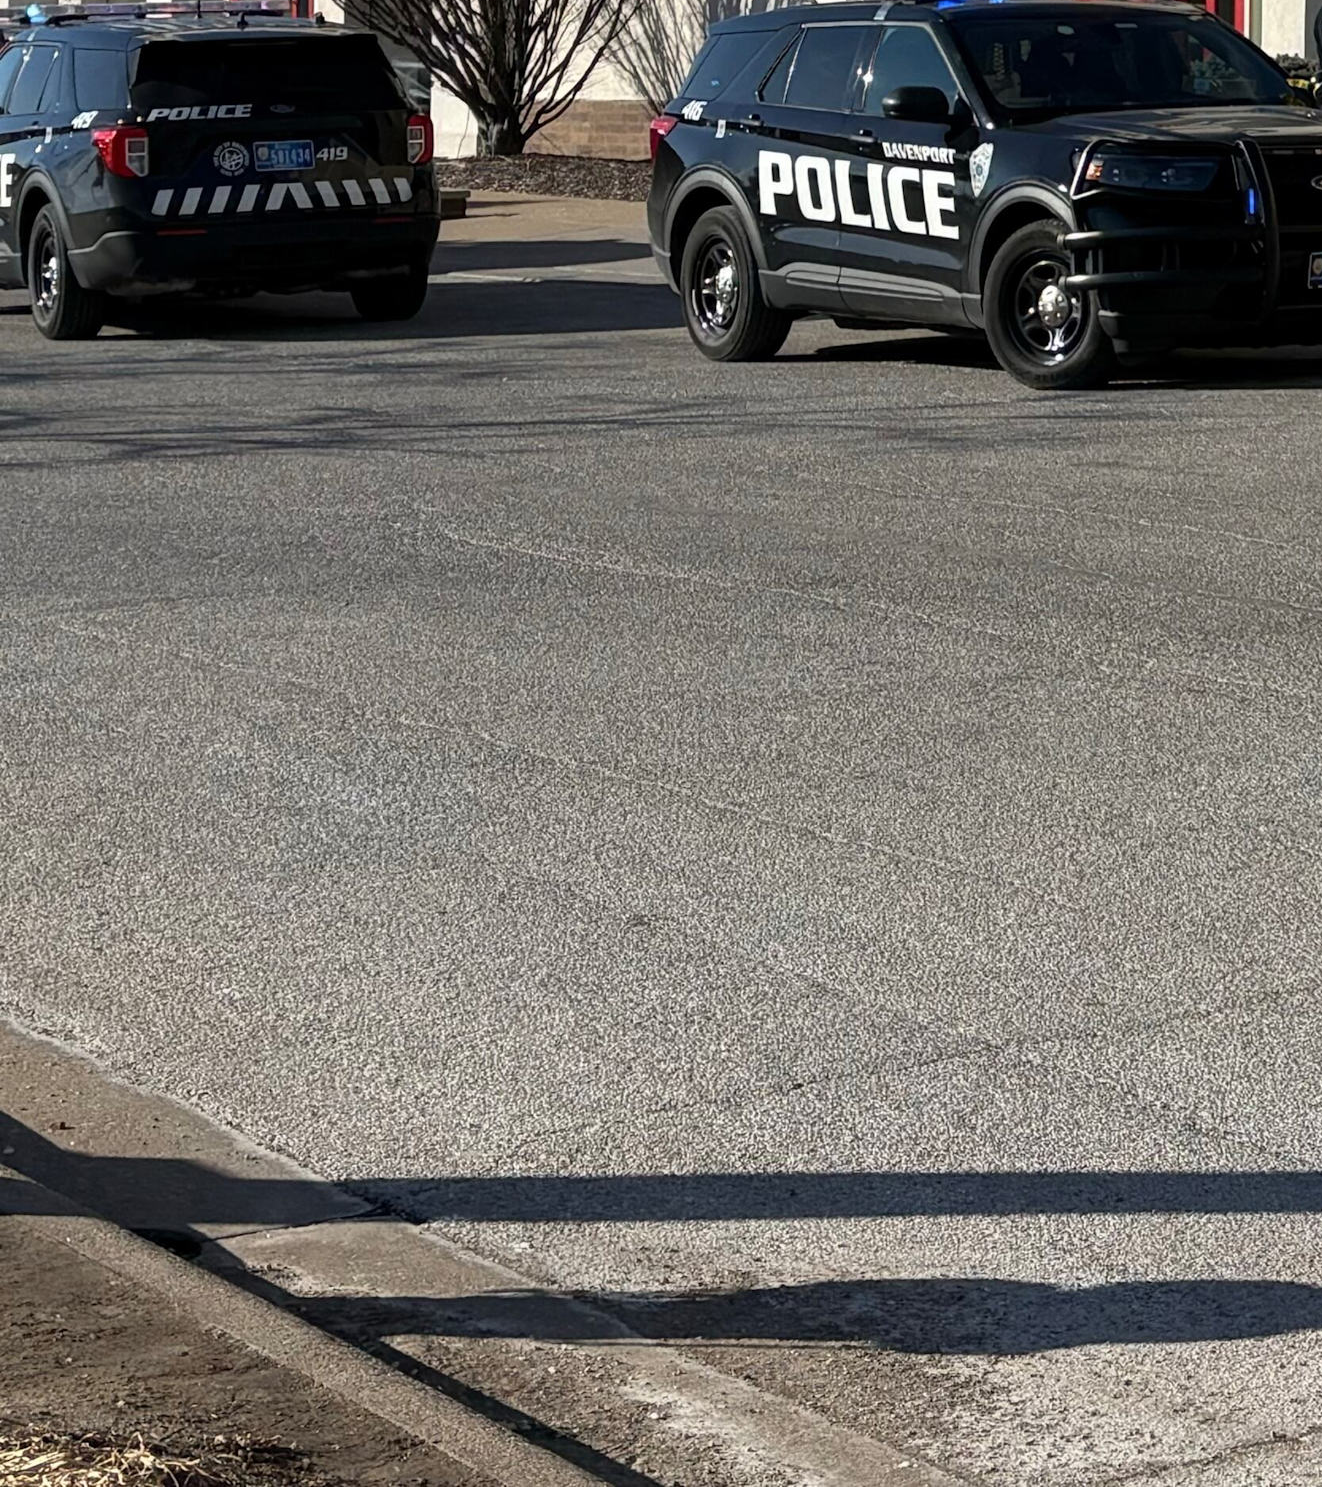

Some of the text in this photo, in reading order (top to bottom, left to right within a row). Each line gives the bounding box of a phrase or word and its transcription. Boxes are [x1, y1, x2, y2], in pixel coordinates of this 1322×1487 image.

[146, 104, 252, 123] POLICE
[681, 100, 708, 121] 416
[316, 146, 348, 161] 419
[882, 141, 956, 164] DAVENPORT
[758, 150, 960, 240] POLICE
